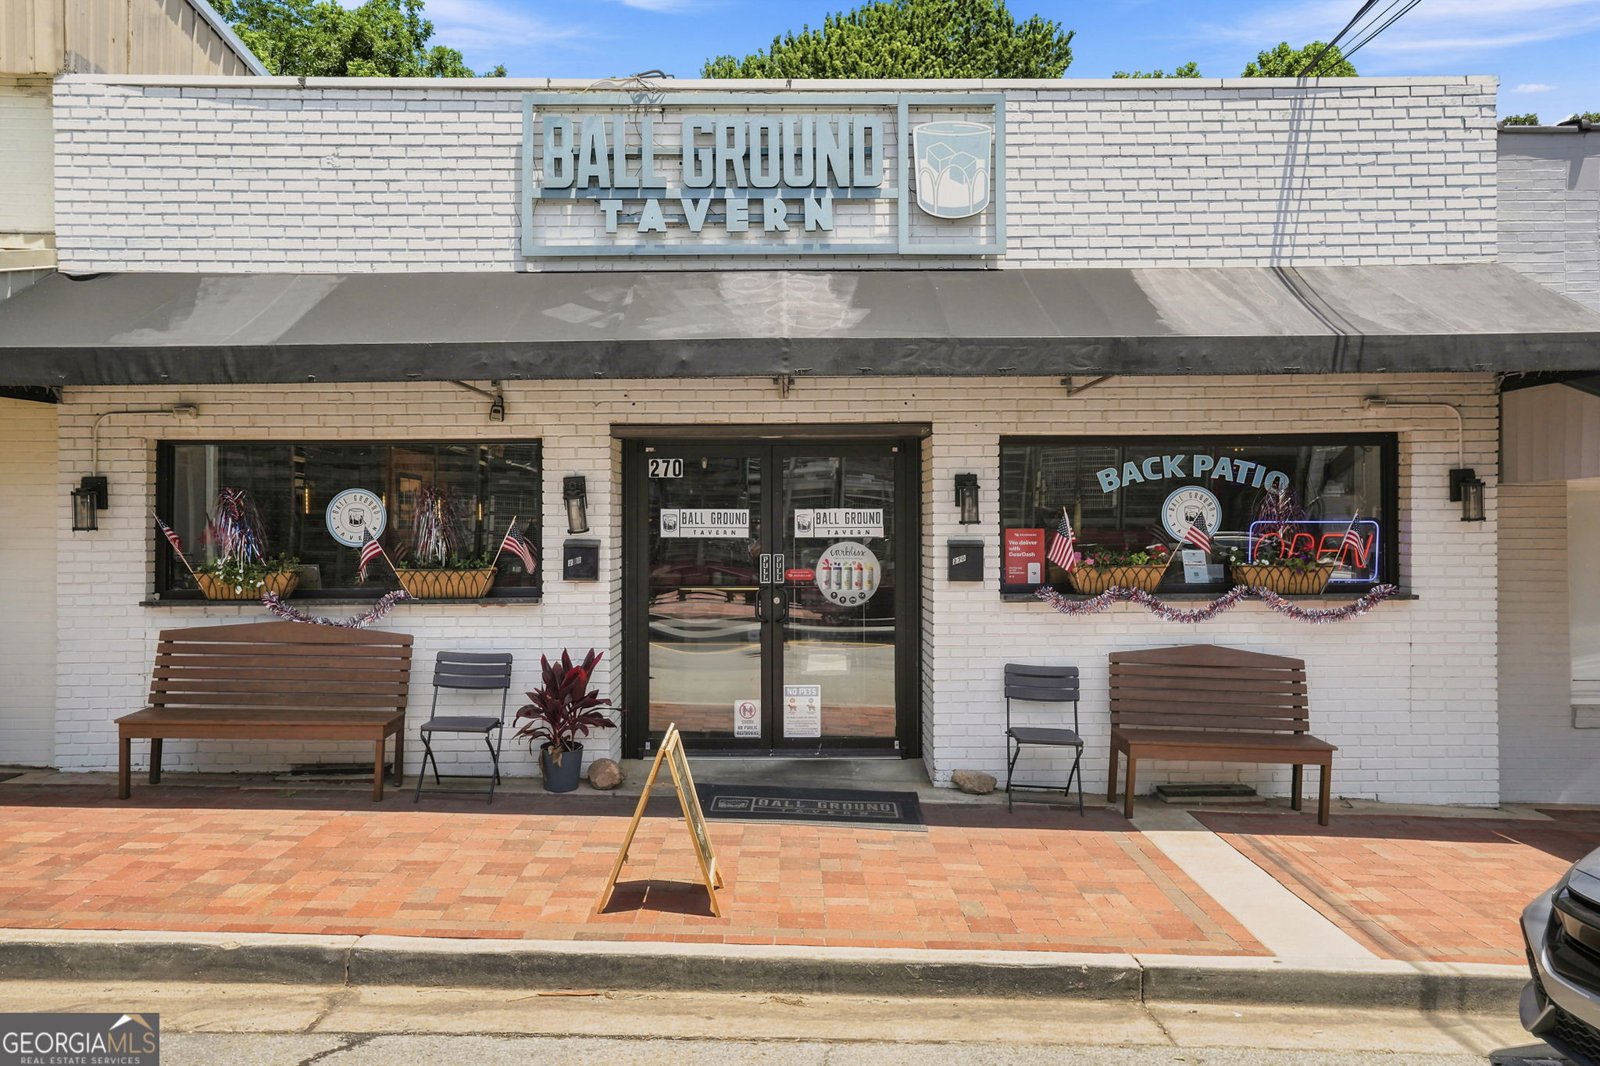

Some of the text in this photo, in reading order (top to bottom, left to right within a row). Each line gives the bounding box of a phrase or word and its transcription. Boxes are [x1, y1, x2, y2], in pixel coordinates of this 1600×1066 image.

[543, 115, 884, 188] BALL GROUND
[600, 198, 834, 233] TAVERN
[650, 459, 682, 477] 270
[1096, 454, 1290, 494] BACK PATIO
[681, 512, 747, 525] BALL GROUND
[815, 512, 881, 525] BALL GROUND
[335, 525, 378, 541] TAVEN
[1253, 532, 1374, 569] OPEN
[786, 687, 817, 695] NO PETS
[758, 798, 891, 812] BALL GROUND
